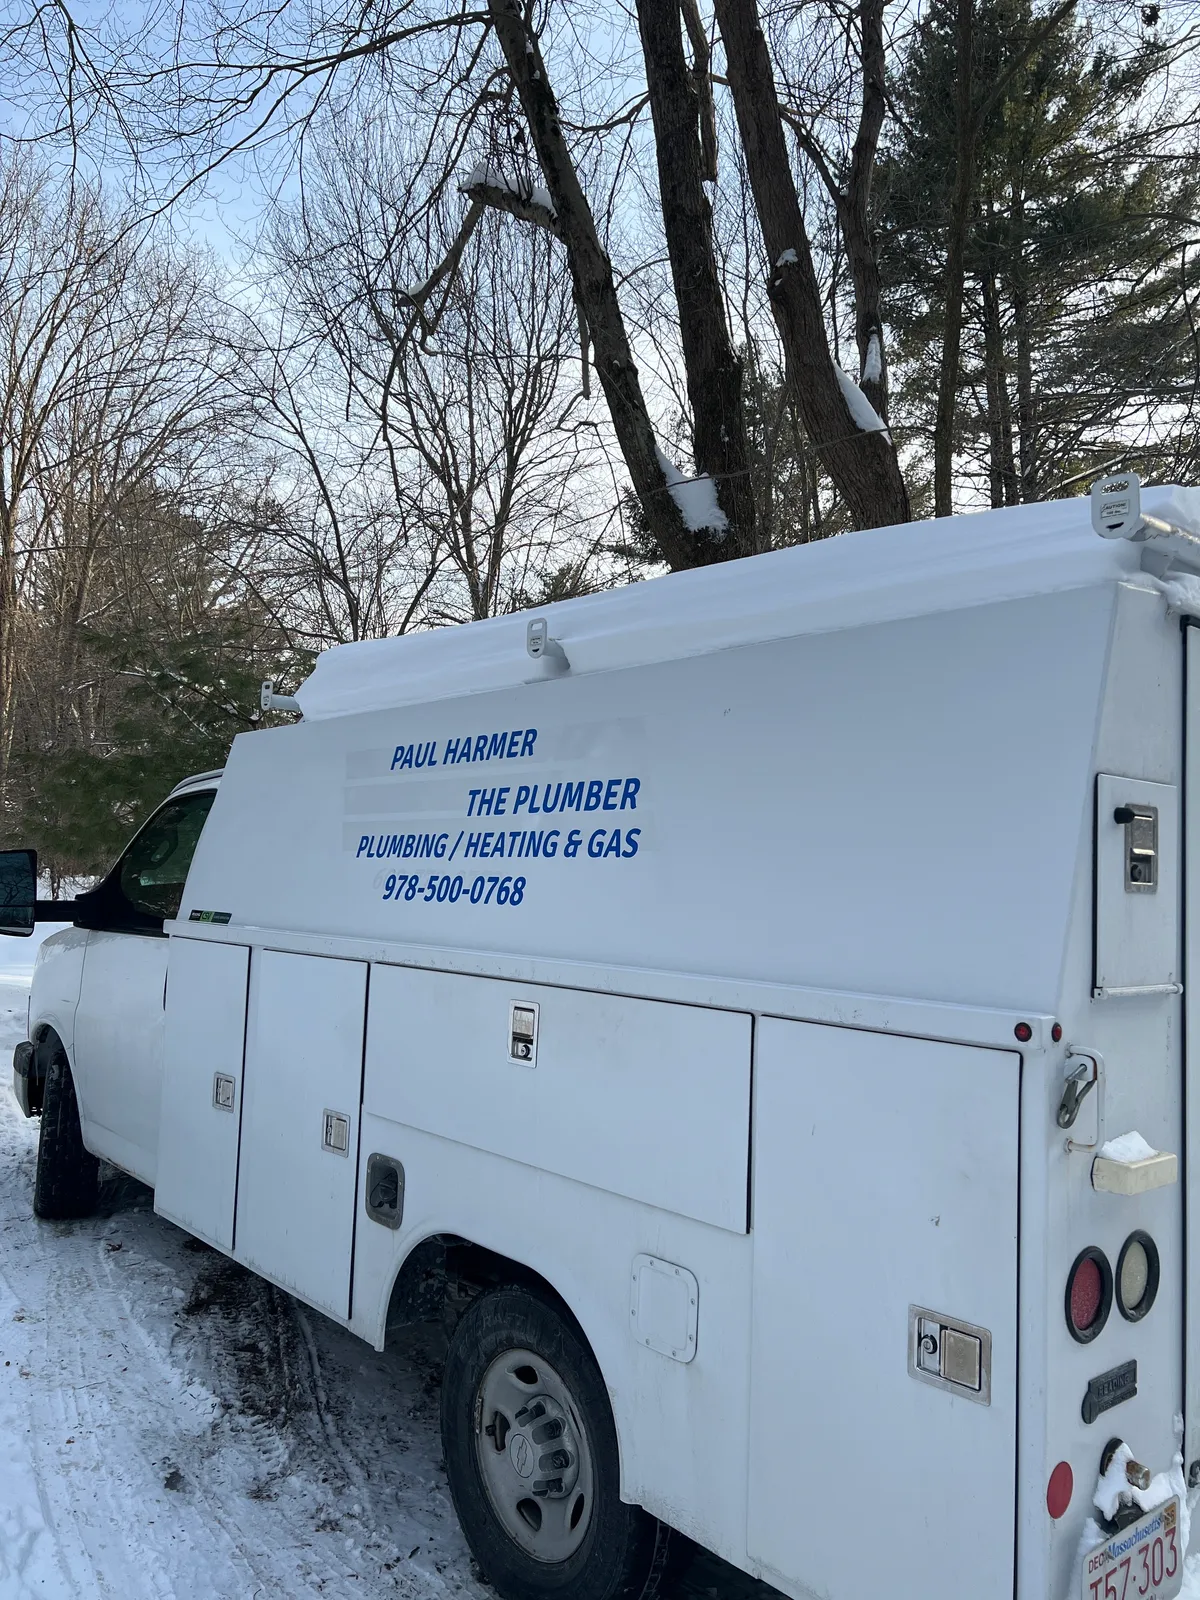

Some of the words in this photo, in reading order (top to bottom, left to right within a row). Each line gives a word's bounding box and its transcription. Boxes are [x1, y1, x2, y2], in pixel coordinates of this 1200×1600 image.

[390, 741, 437, 770] PAUL
[443, 728, 538, 764] HARMER
[467, 787, 510, 816] THE
[513, 777, 641, 814] PLUMBER
[563, 829, 583, 858] &
[587, 828, 641, 858] GAS
[382, 874, 526, 906] 978-500-0768
